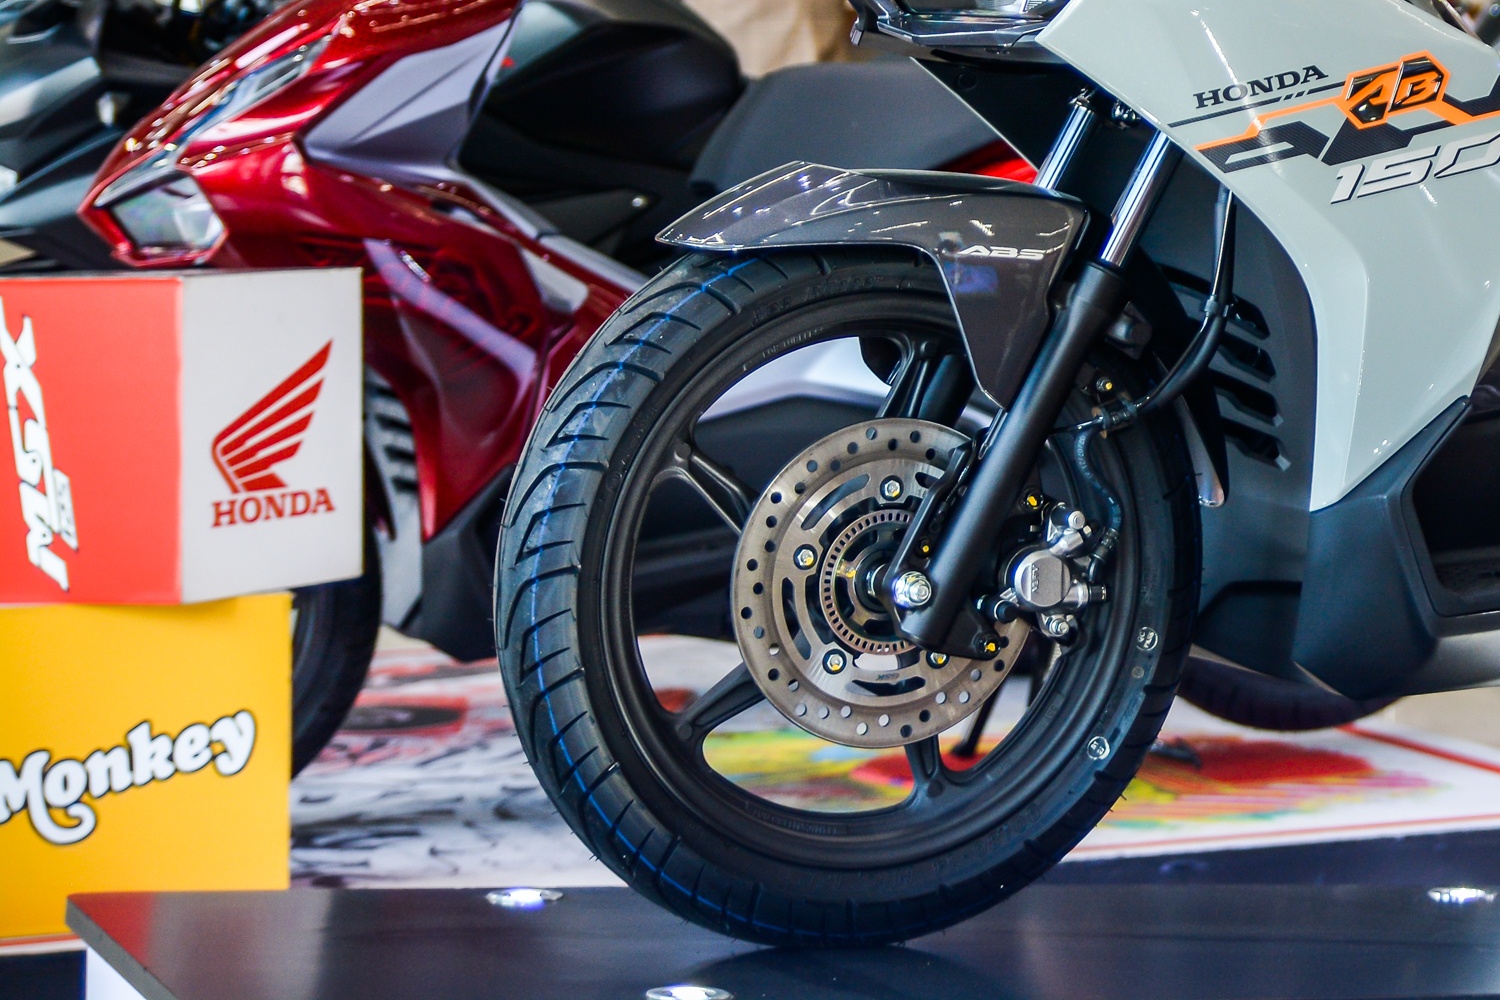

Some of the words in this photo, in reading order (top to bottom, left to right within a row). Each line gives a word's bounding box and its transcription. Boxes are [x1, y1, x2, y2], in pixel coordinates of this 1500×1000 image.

[1193, 64, 1329, 109] HONDA
[956, 244, 1046, 261] ABS
[210, 487, 335, 529] HONDA
[0, 709, 257, 846] Monkey
